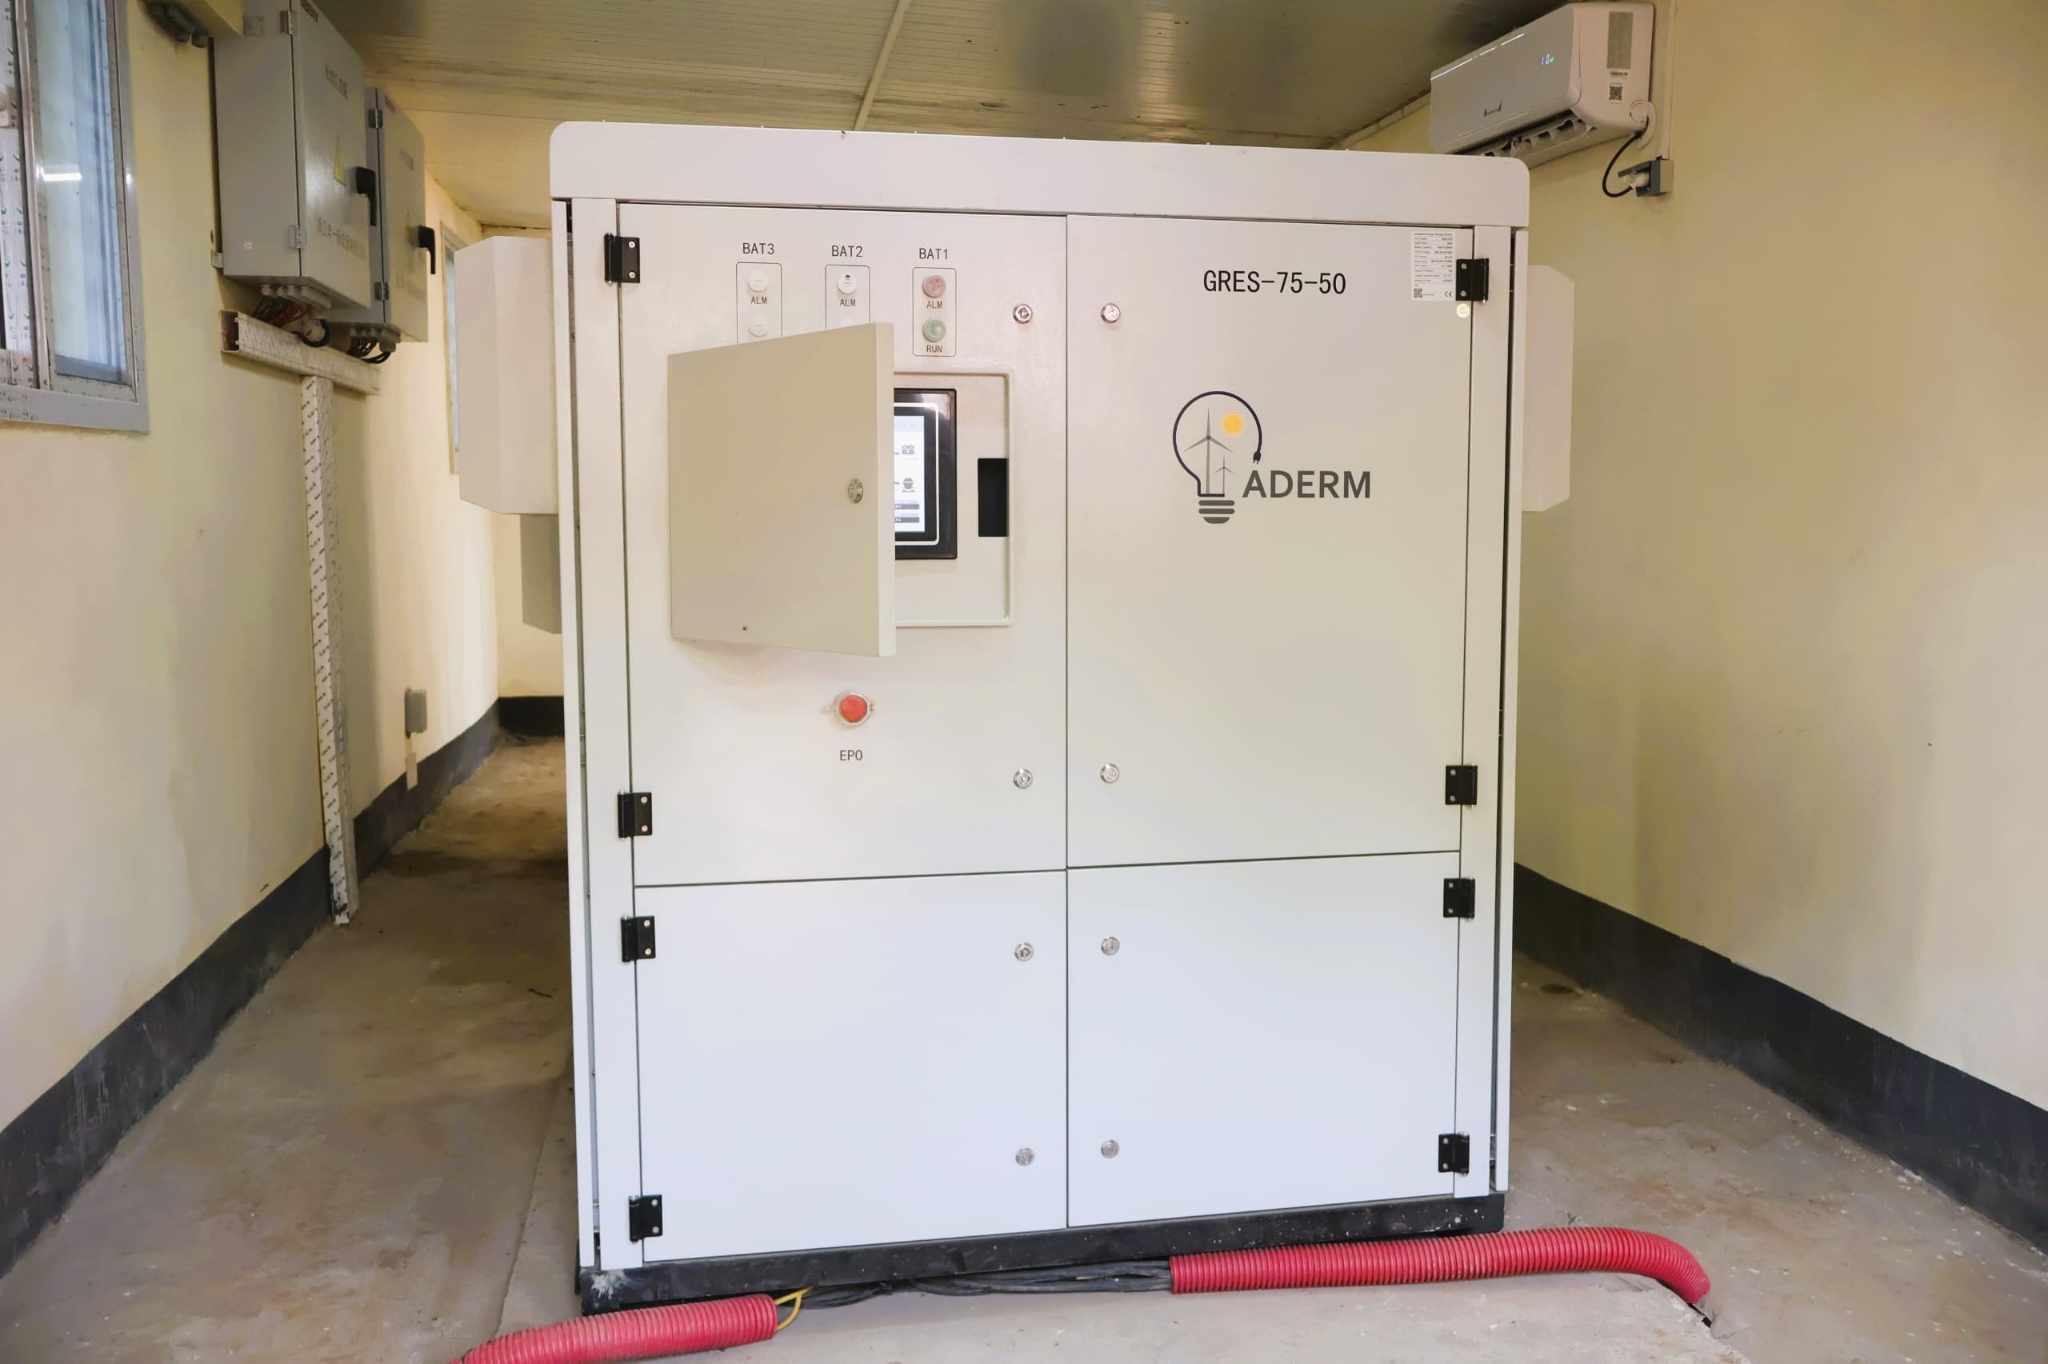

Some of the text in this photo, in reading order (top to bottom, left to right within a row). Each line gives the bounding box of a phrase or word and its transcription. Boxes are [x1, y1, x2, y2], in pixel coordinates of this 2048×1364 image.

[742, 242, 775, 255] BAT3
[831, 245, 864, 257] BAT2
[919, 247, 949, 260] BAT1
[1203, 270, 1346, 294] GRES-75-50
[750, 296, 768, 305] ALM
[839, 298, 856, 307] ALM
[926, 300, 943, 309] ALM
[926, 344, 943, 353] RUN
[1242, 470, 1371, 498] ADERM
